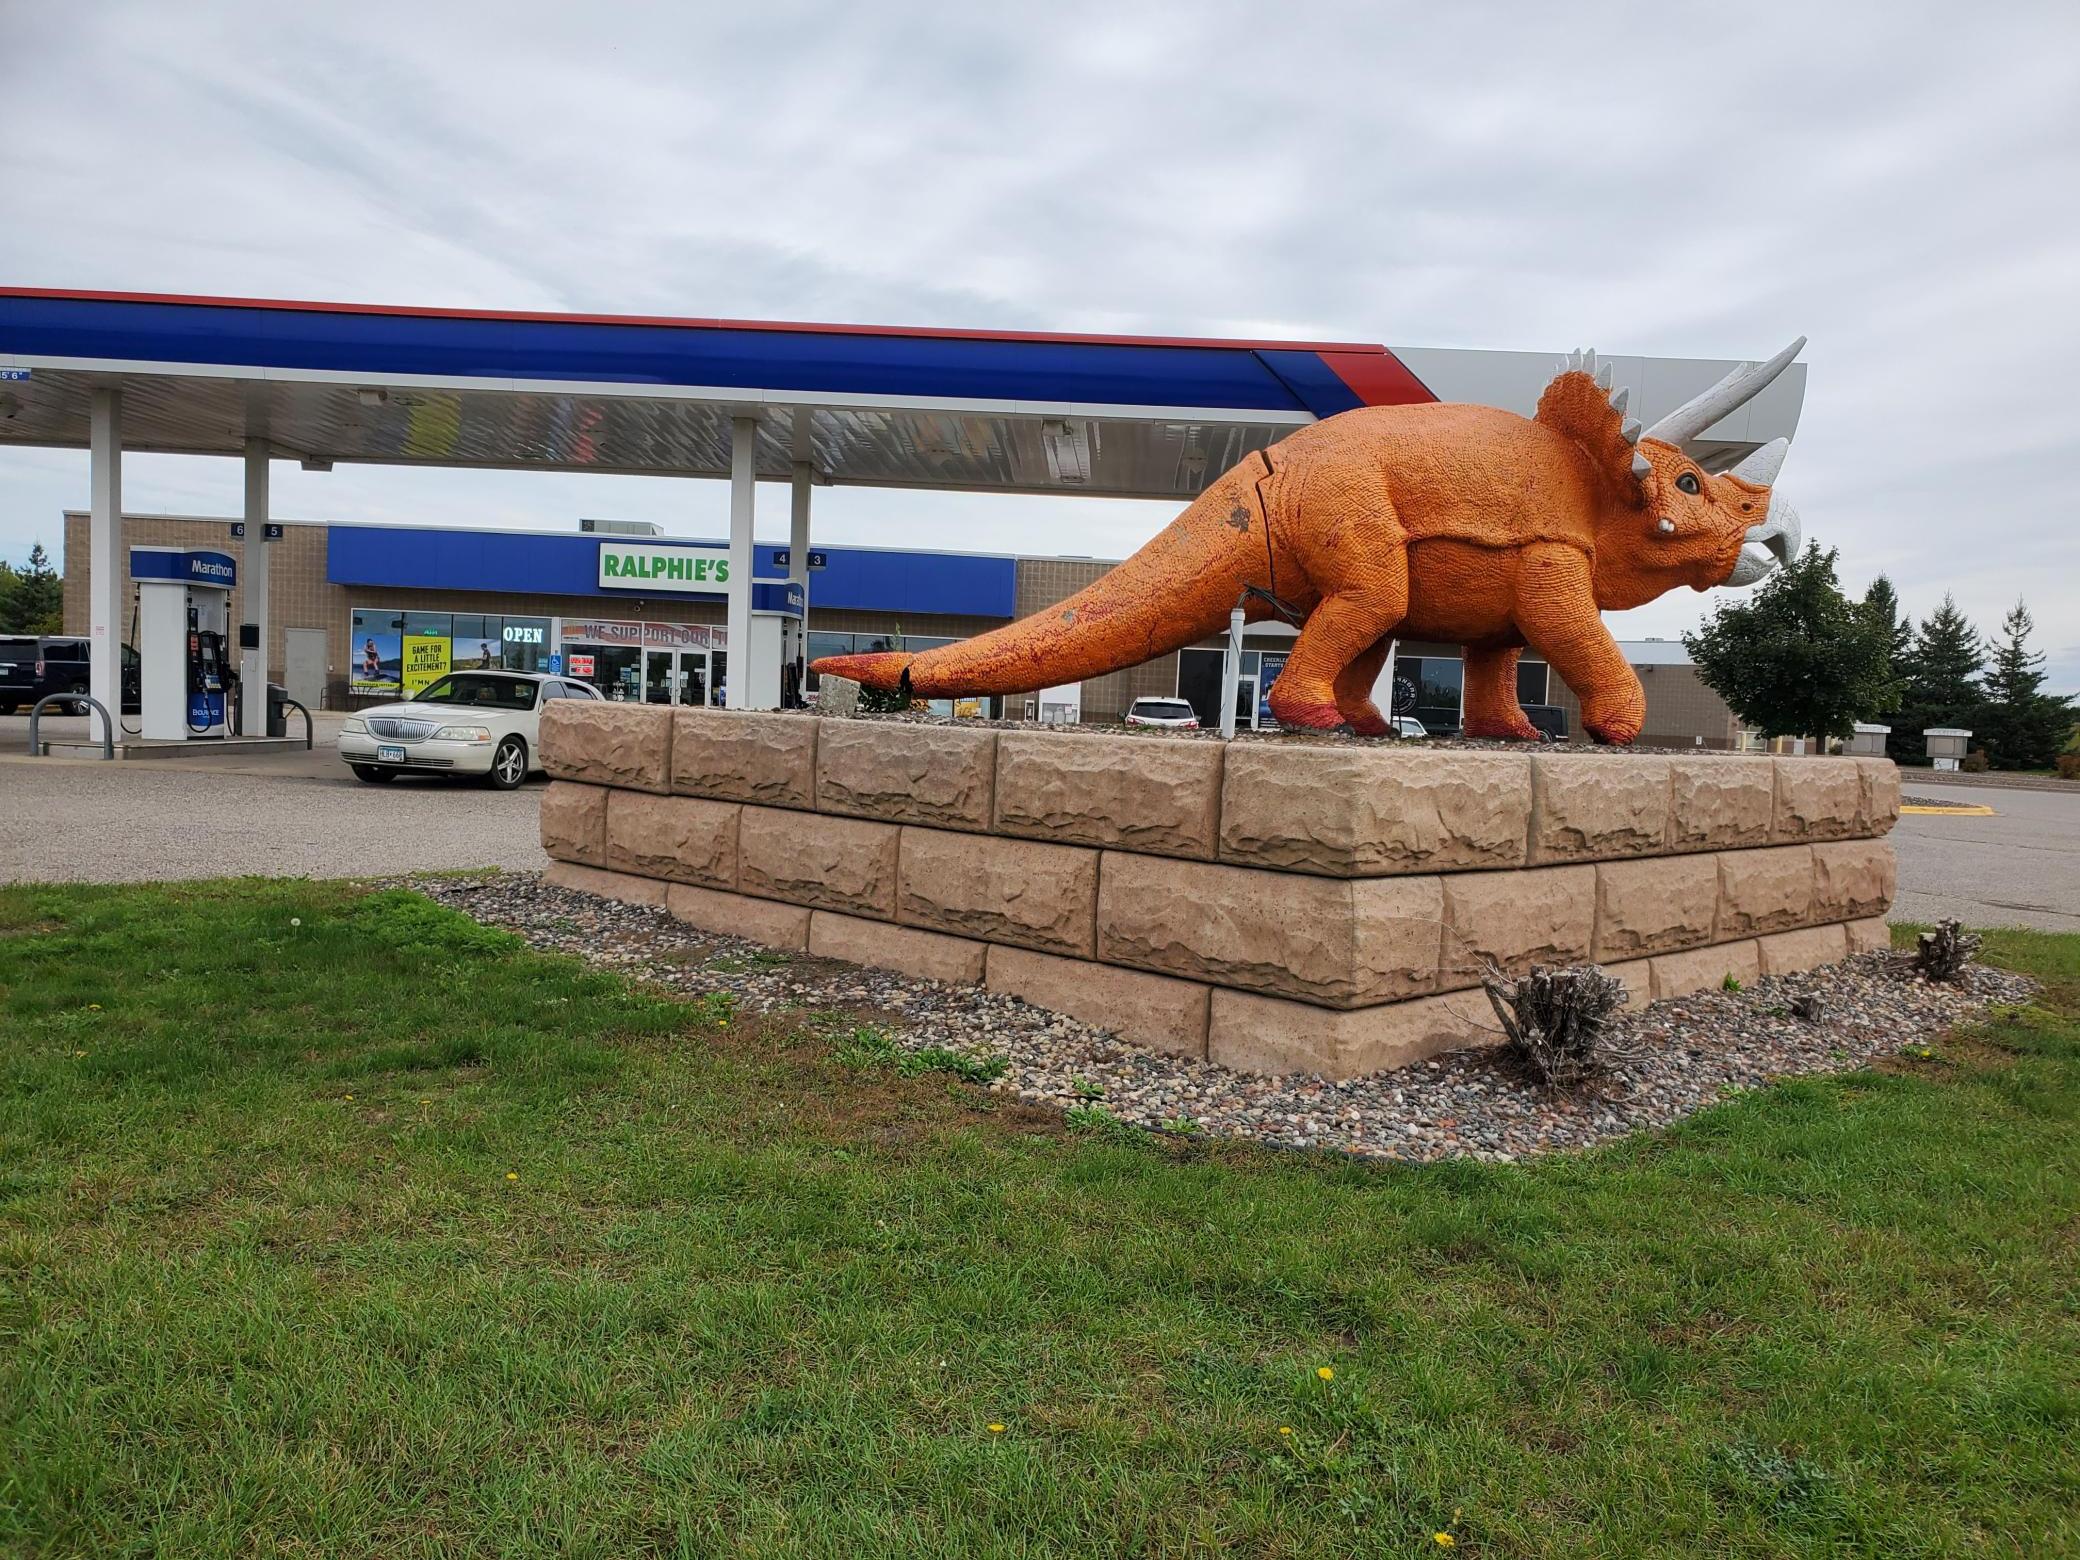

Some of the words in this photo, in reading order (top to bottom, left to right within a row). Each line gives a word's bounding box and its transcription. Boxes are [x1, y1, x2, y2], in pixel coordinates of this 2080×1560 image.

[236, 525, 244, 535] 6
[271, 526, 278, 536] 5
[779, 554, 786, 563] 4
[814, 555, 821, 565] 3
[191, 559, 233, 578] Marathon
[604, 554, 730, 583] RALPHIE'S
[503, 626, 543, 643] OPEN
[584, 624, 605, 639] WE
[611, 626, 675, 643] SUPPORT
[681, 629, 709, 645] OUR
[412, 646, 429, 655] GAME
[431, 644, 442, 654] FOR
[421, 653, 440, 662] LITTLE
[406, 662, 447, 673] EXCITEMENT?
